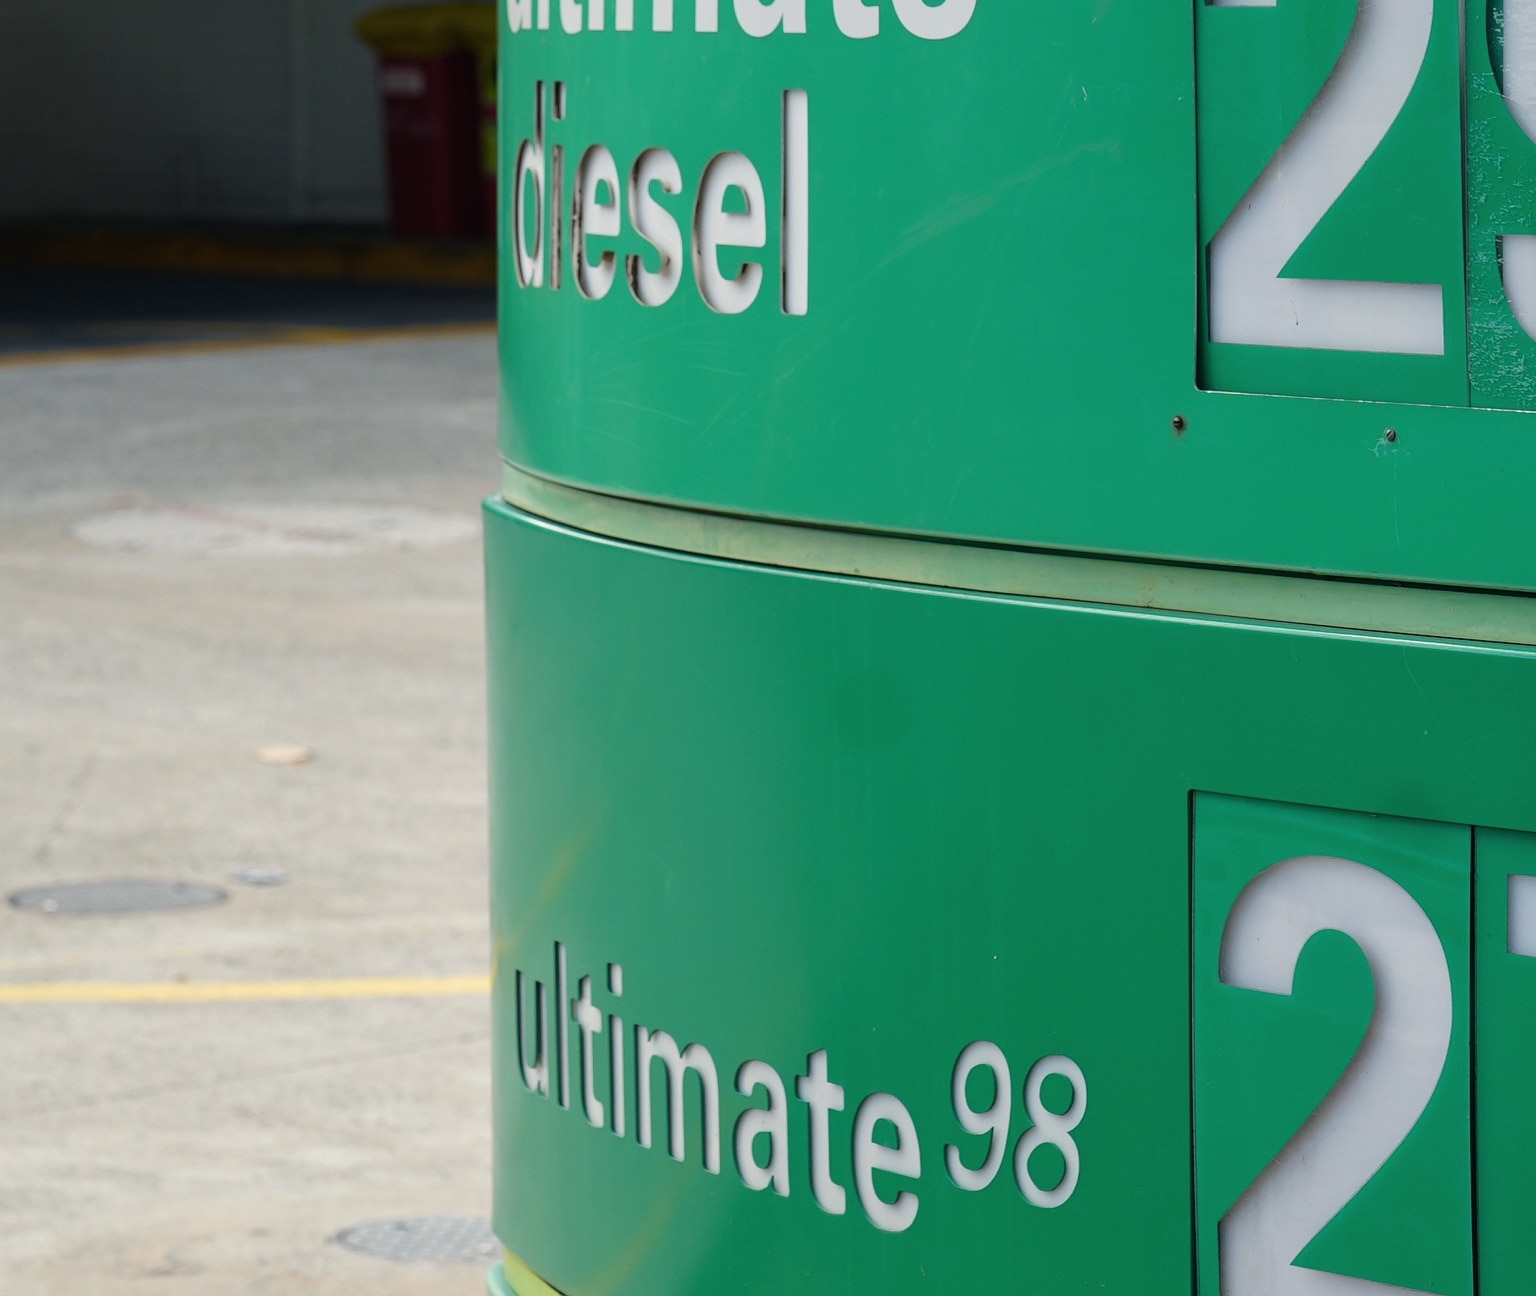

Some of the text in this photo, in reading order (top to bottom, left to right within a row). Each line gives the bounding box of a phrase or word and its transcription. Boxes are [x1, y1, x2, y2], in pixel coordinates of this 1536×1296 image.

[512, 80, 809, 316] diesel
[515, 940, 1087, 1233] ultimate 98
